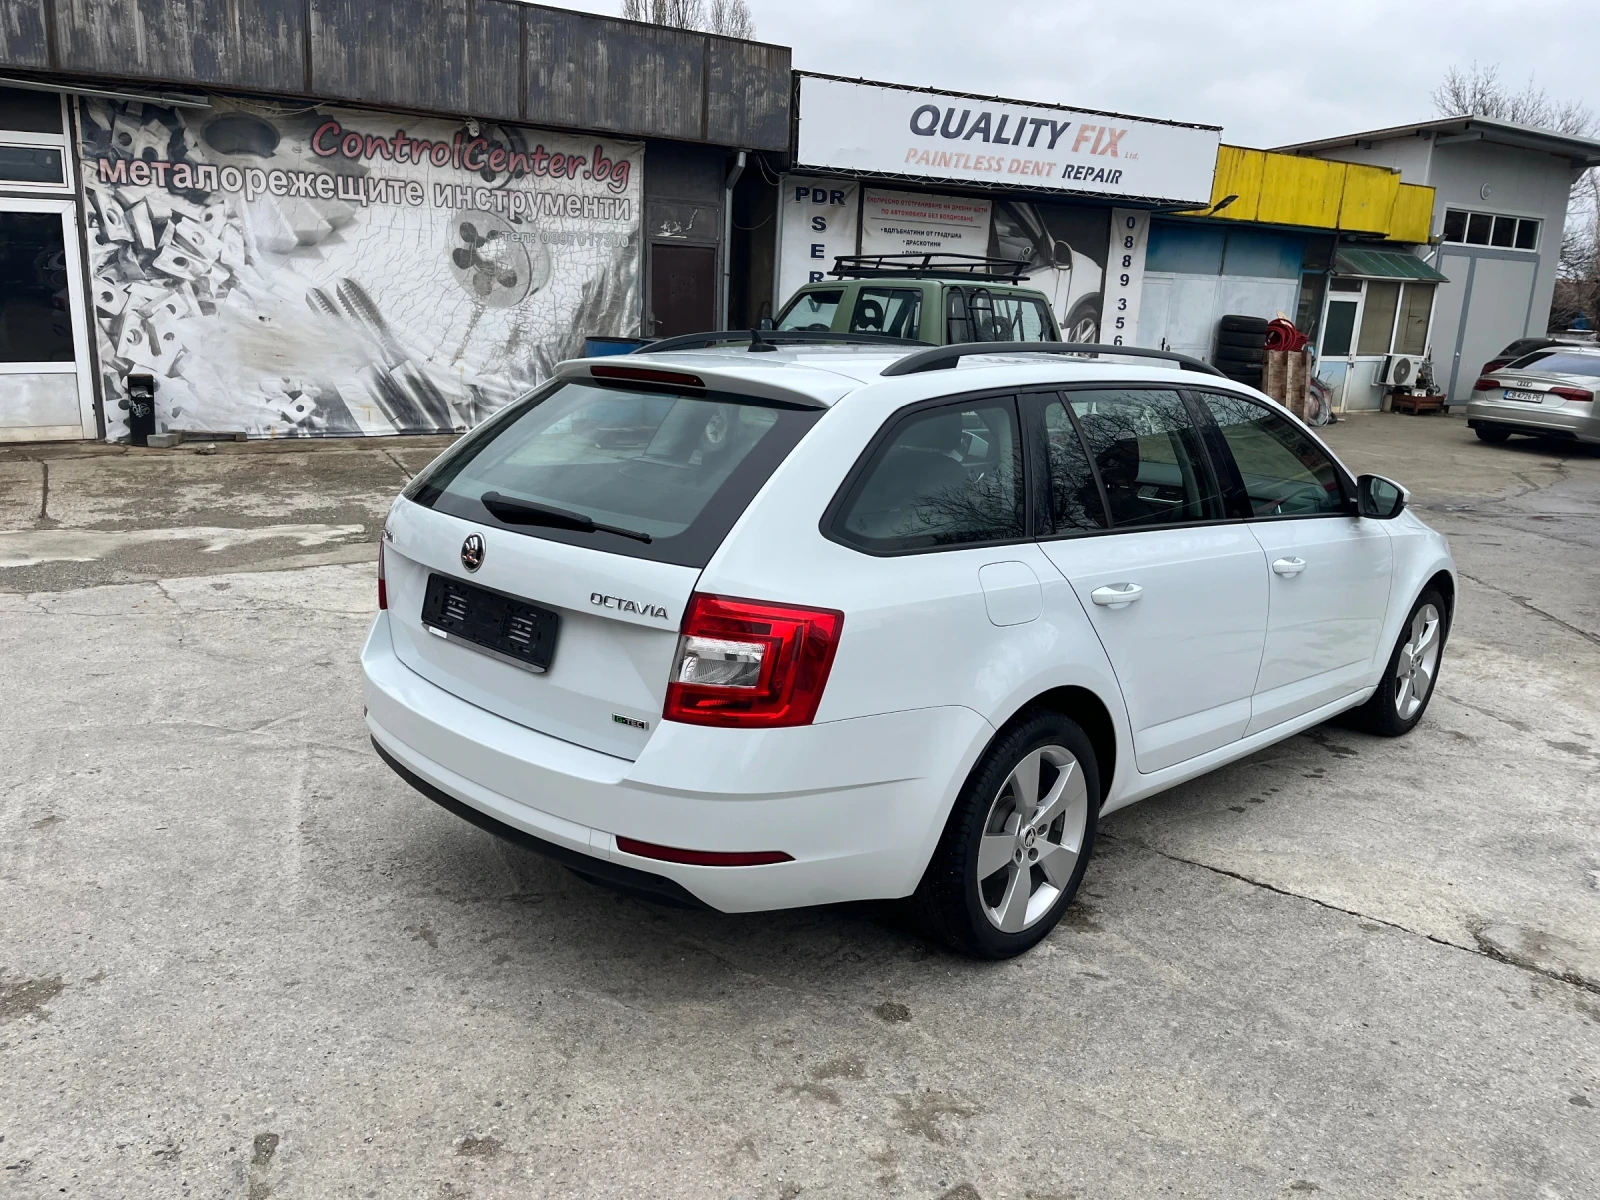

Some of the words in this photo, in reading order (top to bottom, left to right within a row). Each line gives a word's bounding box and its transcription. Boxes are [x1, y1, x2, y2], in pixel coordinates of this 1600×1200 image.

[909, 104, 1071, 149] QUALITY
[1071, 123, 1128, 158] FIX
[1124, 151, 1139, 160] Ltd.
[311, 120, 631, 194] ControlCenter.bg
[904, 147, 1004, 173] PAINTLESS
[1007, 158, 1056, 177] DENT
[1061, 163, 1123, 184] REPAIR
[98, 156, 425, 208] металорежещите
[433, 182, 631, 222] инструменти
[795, 186, 846, 206] PDR
[501, 231, 536, 244] тел:
[905, 239, 942, 247] ДРАСКОТИНИ
[934, 231, 962, 239] ГРАДУШКА
[590, 592, 670, 620] OCTAVIA
[615, 715, 644, 729] G-TEC
